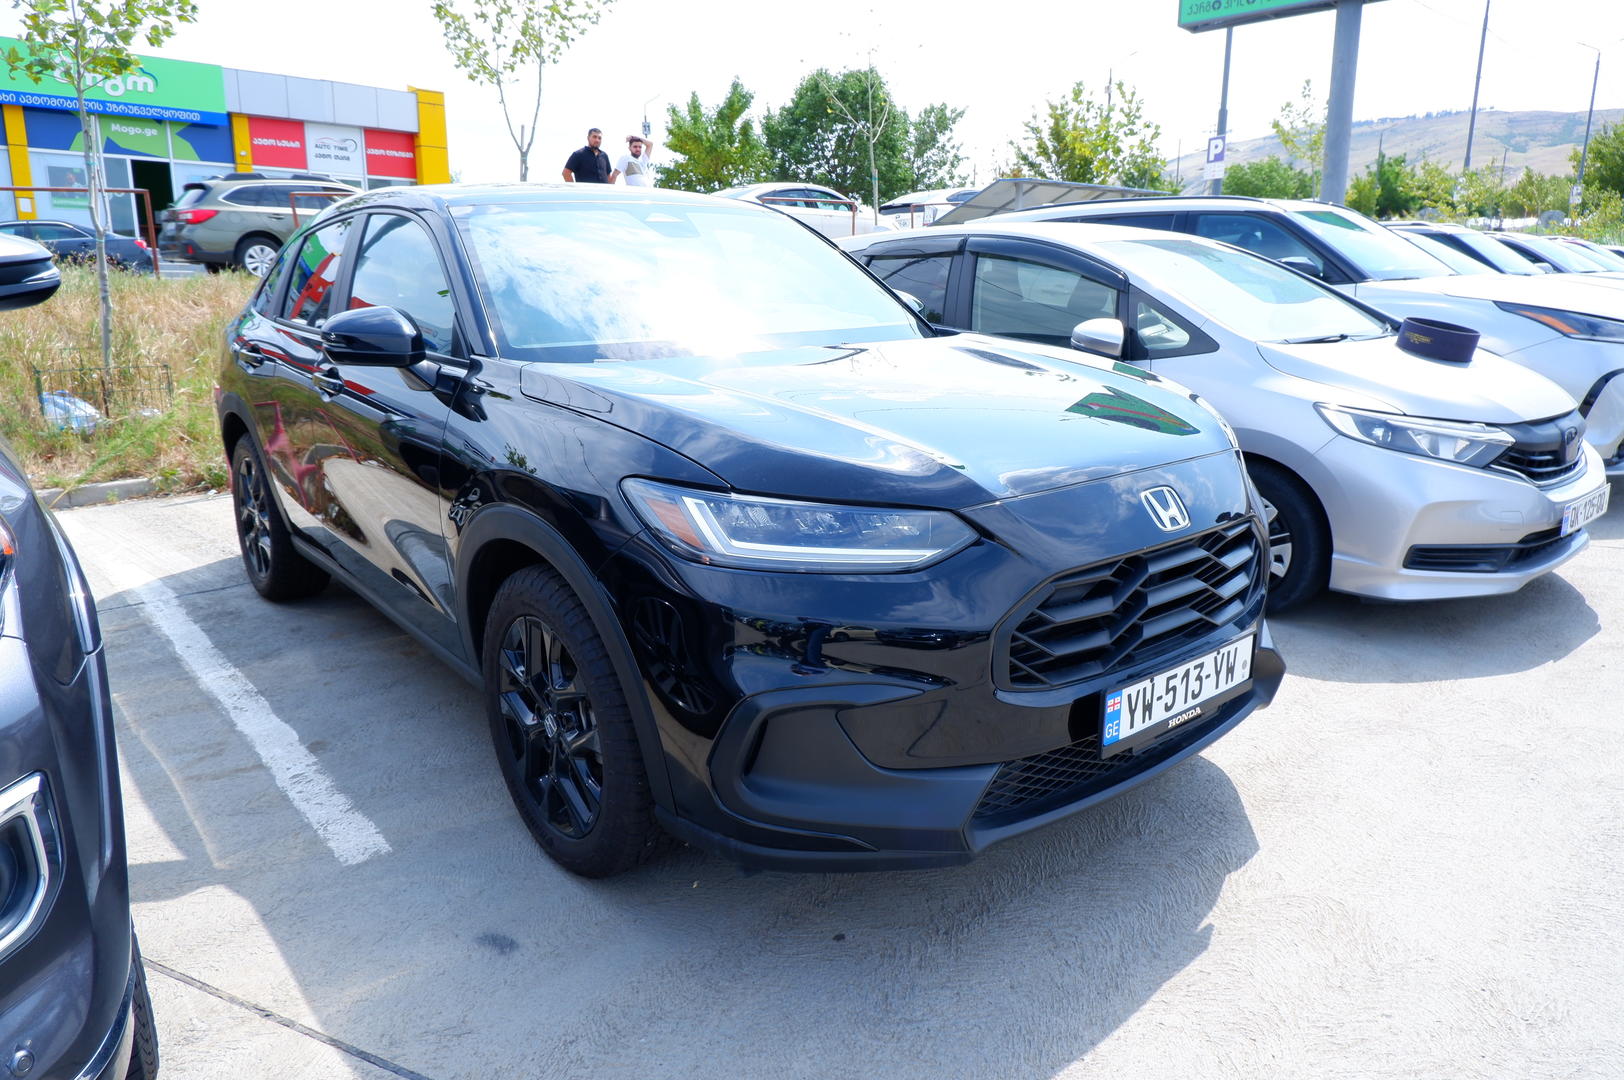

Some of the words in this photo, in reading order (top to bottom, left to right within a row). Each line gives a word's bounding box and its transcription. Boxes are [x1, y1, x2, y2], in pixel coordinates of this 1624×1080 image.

[111, 123, 158, 136] Mogo.ge
[333, 145, 349, 153] TIME
[1209, 138, 1224, 161] P
[1127, 647, 1238, 730] YW-513-YW
[1168, 706, 1202, 729] HONDA
[1105, 719, 1120, 739] GE
